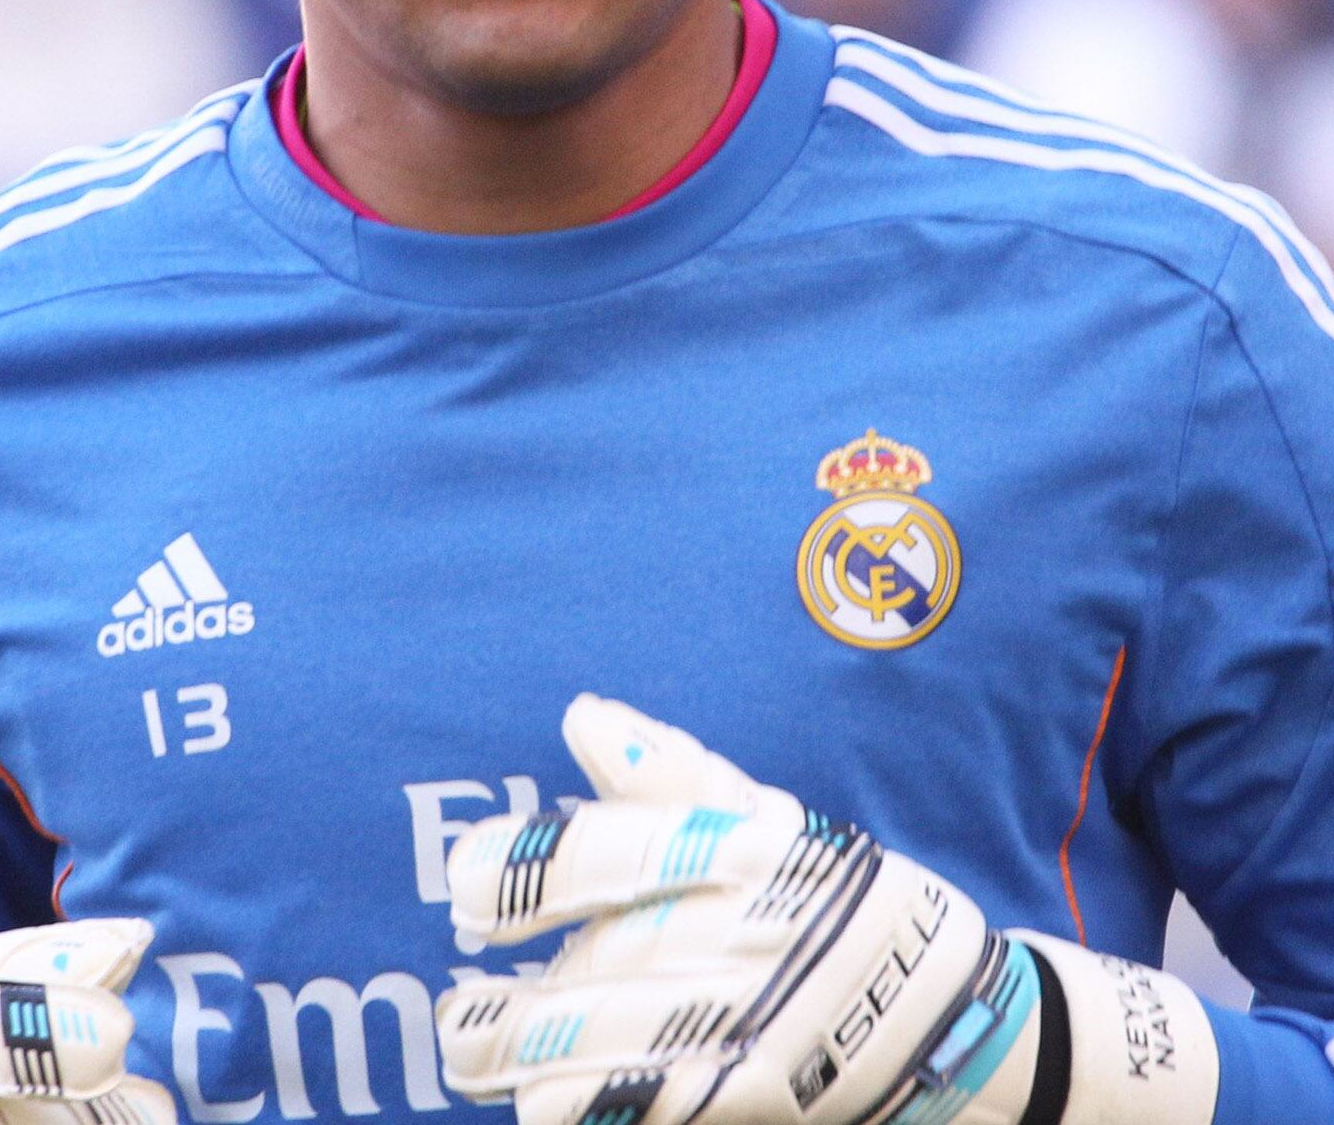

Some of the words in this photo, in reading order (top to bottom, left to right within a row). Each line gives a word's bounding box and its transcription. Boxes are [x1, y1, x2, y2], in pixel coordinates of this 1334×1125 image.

[96, 599, 256, 658] adidas
[142, 682, 232, 758] 13
[834, 882, 949, 1061] SELLS
